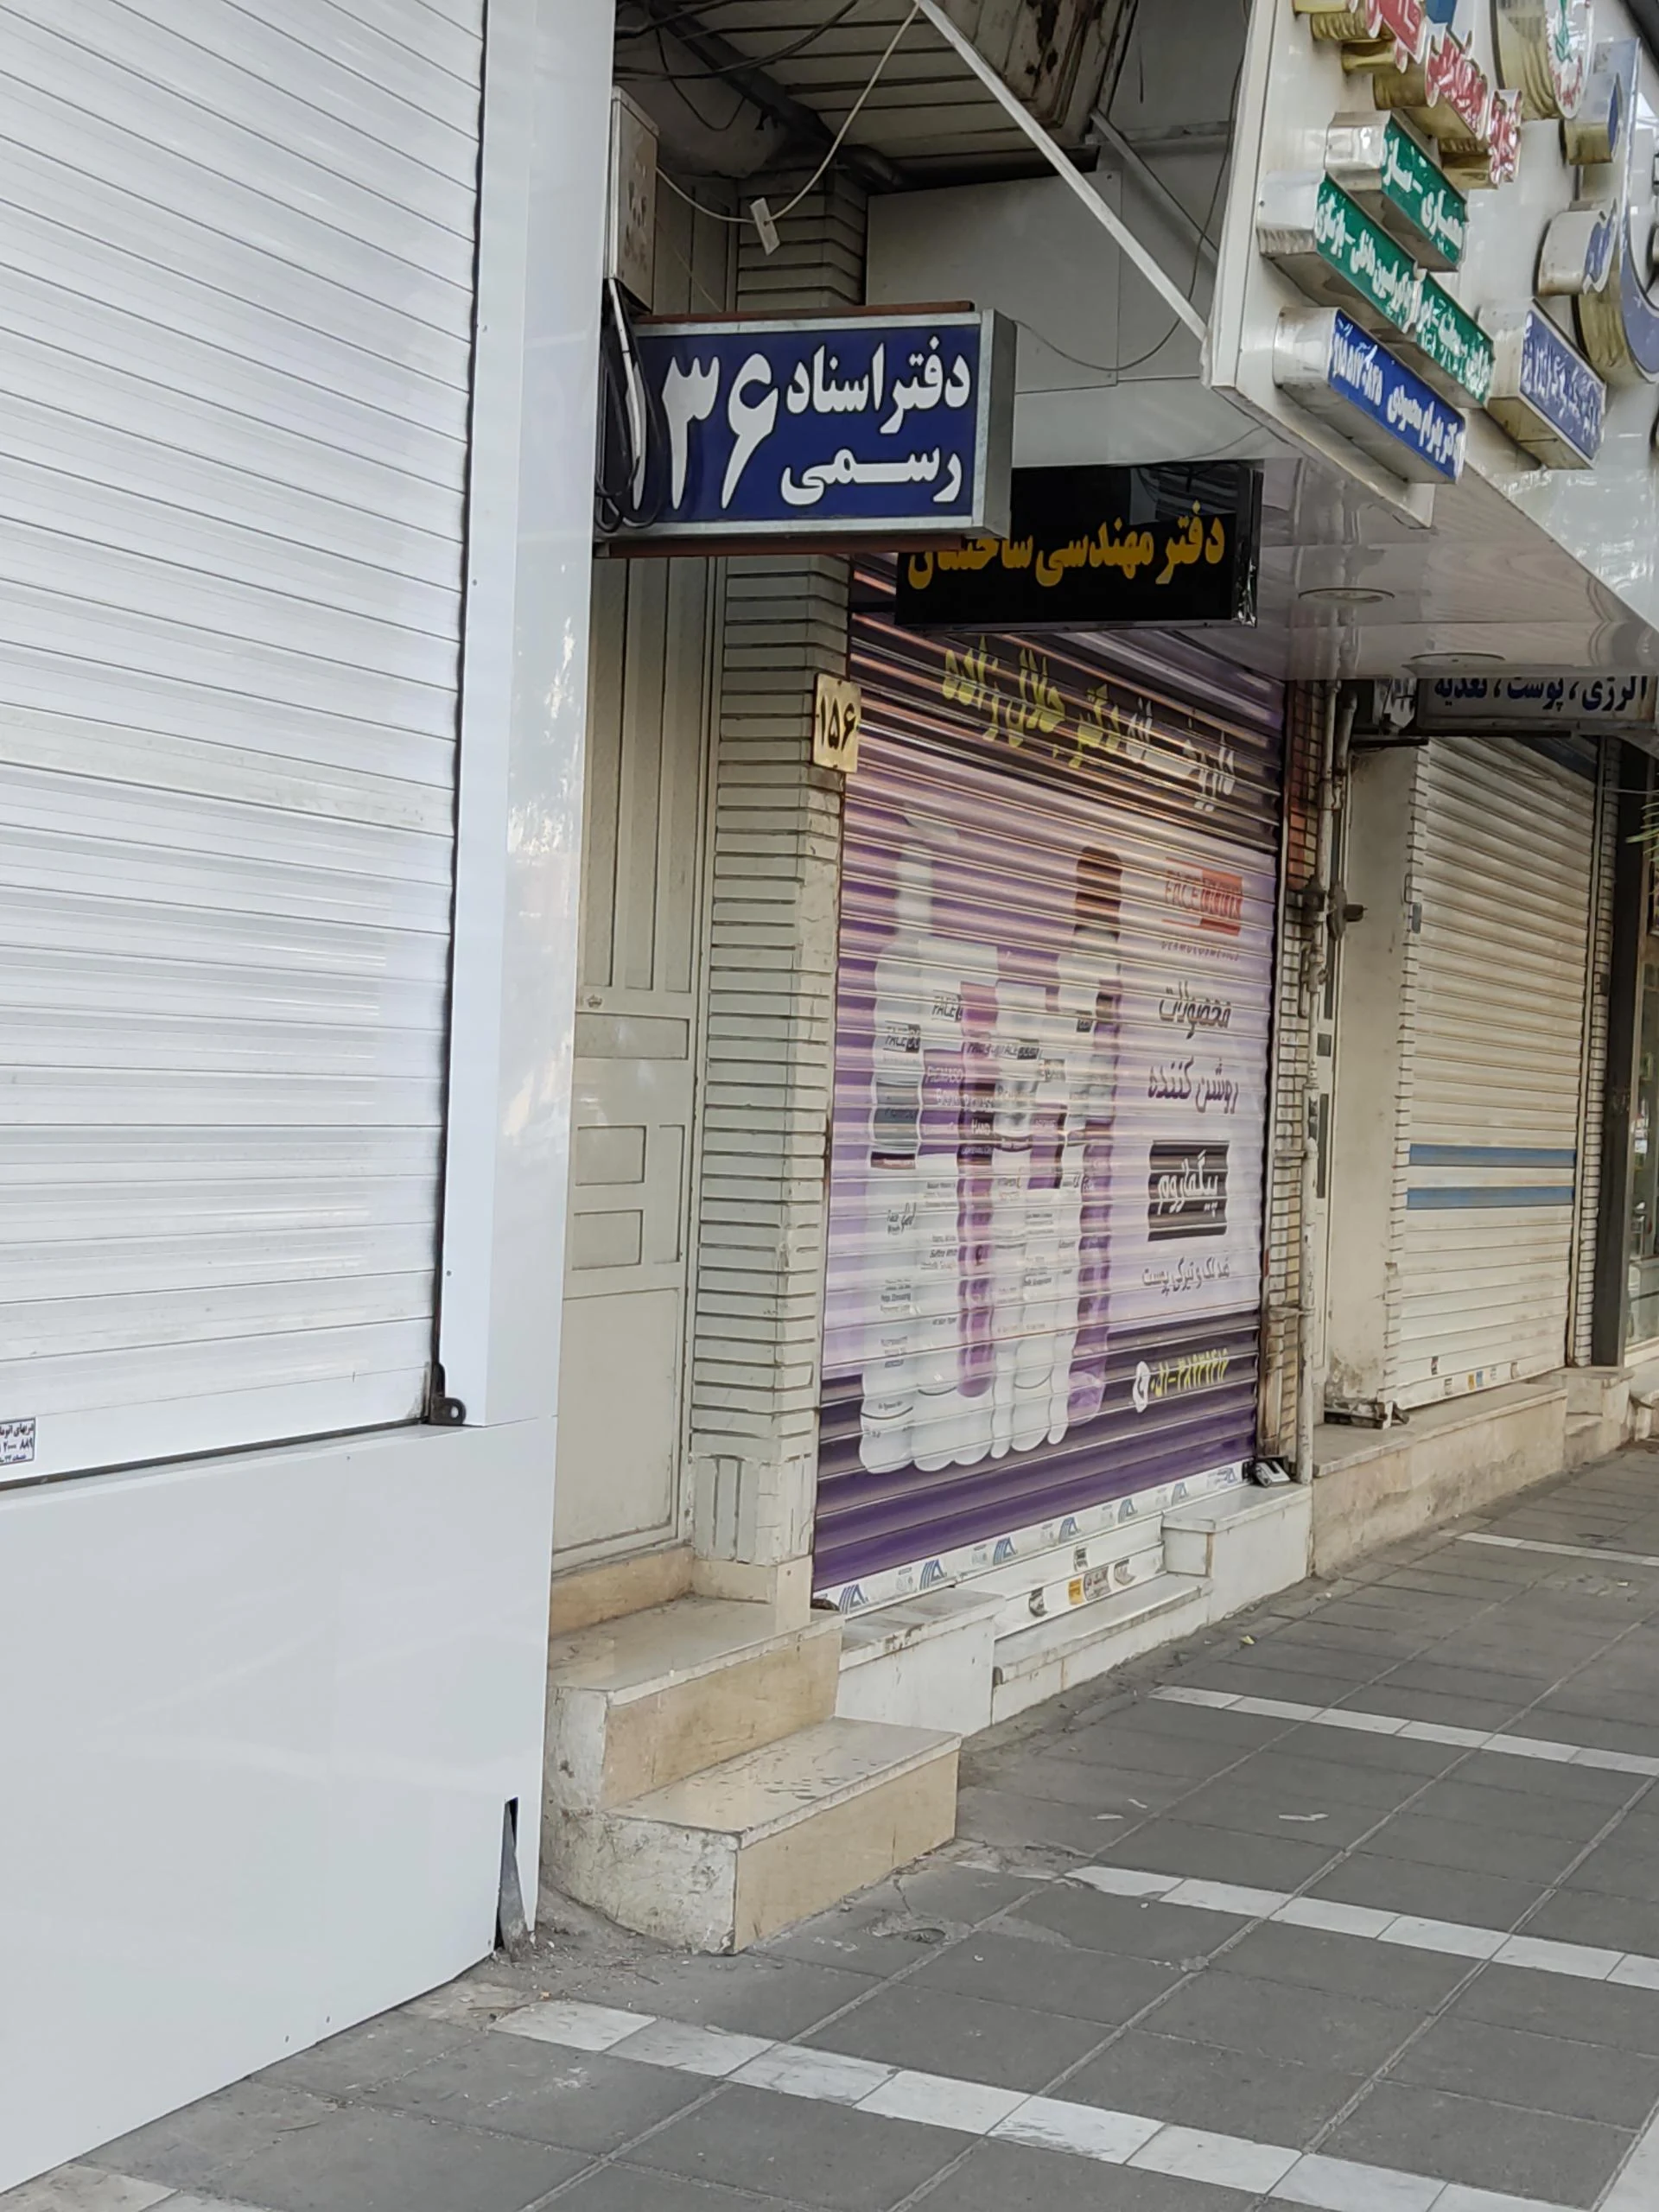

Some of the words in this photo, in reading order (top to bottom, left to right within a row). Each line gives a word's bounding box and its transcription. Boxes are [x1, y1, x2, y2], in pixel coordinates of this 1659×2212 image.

[787, 343, 884, 415] اسناد
[880, 336, 970, 434] دفتر
[781, 446, 962, 506] رسمی
[1036, 517, 1154, 588] مهندسی
[1155, 499, 1225, 585] دفتر
[821, 695, 857, 753] ۱۵۶
[1159, 980, 1232, 1039] محصولات
[1147, 1056, 1194, 1099] کننده
[1196, 1058, 1239, 1114] روشن
